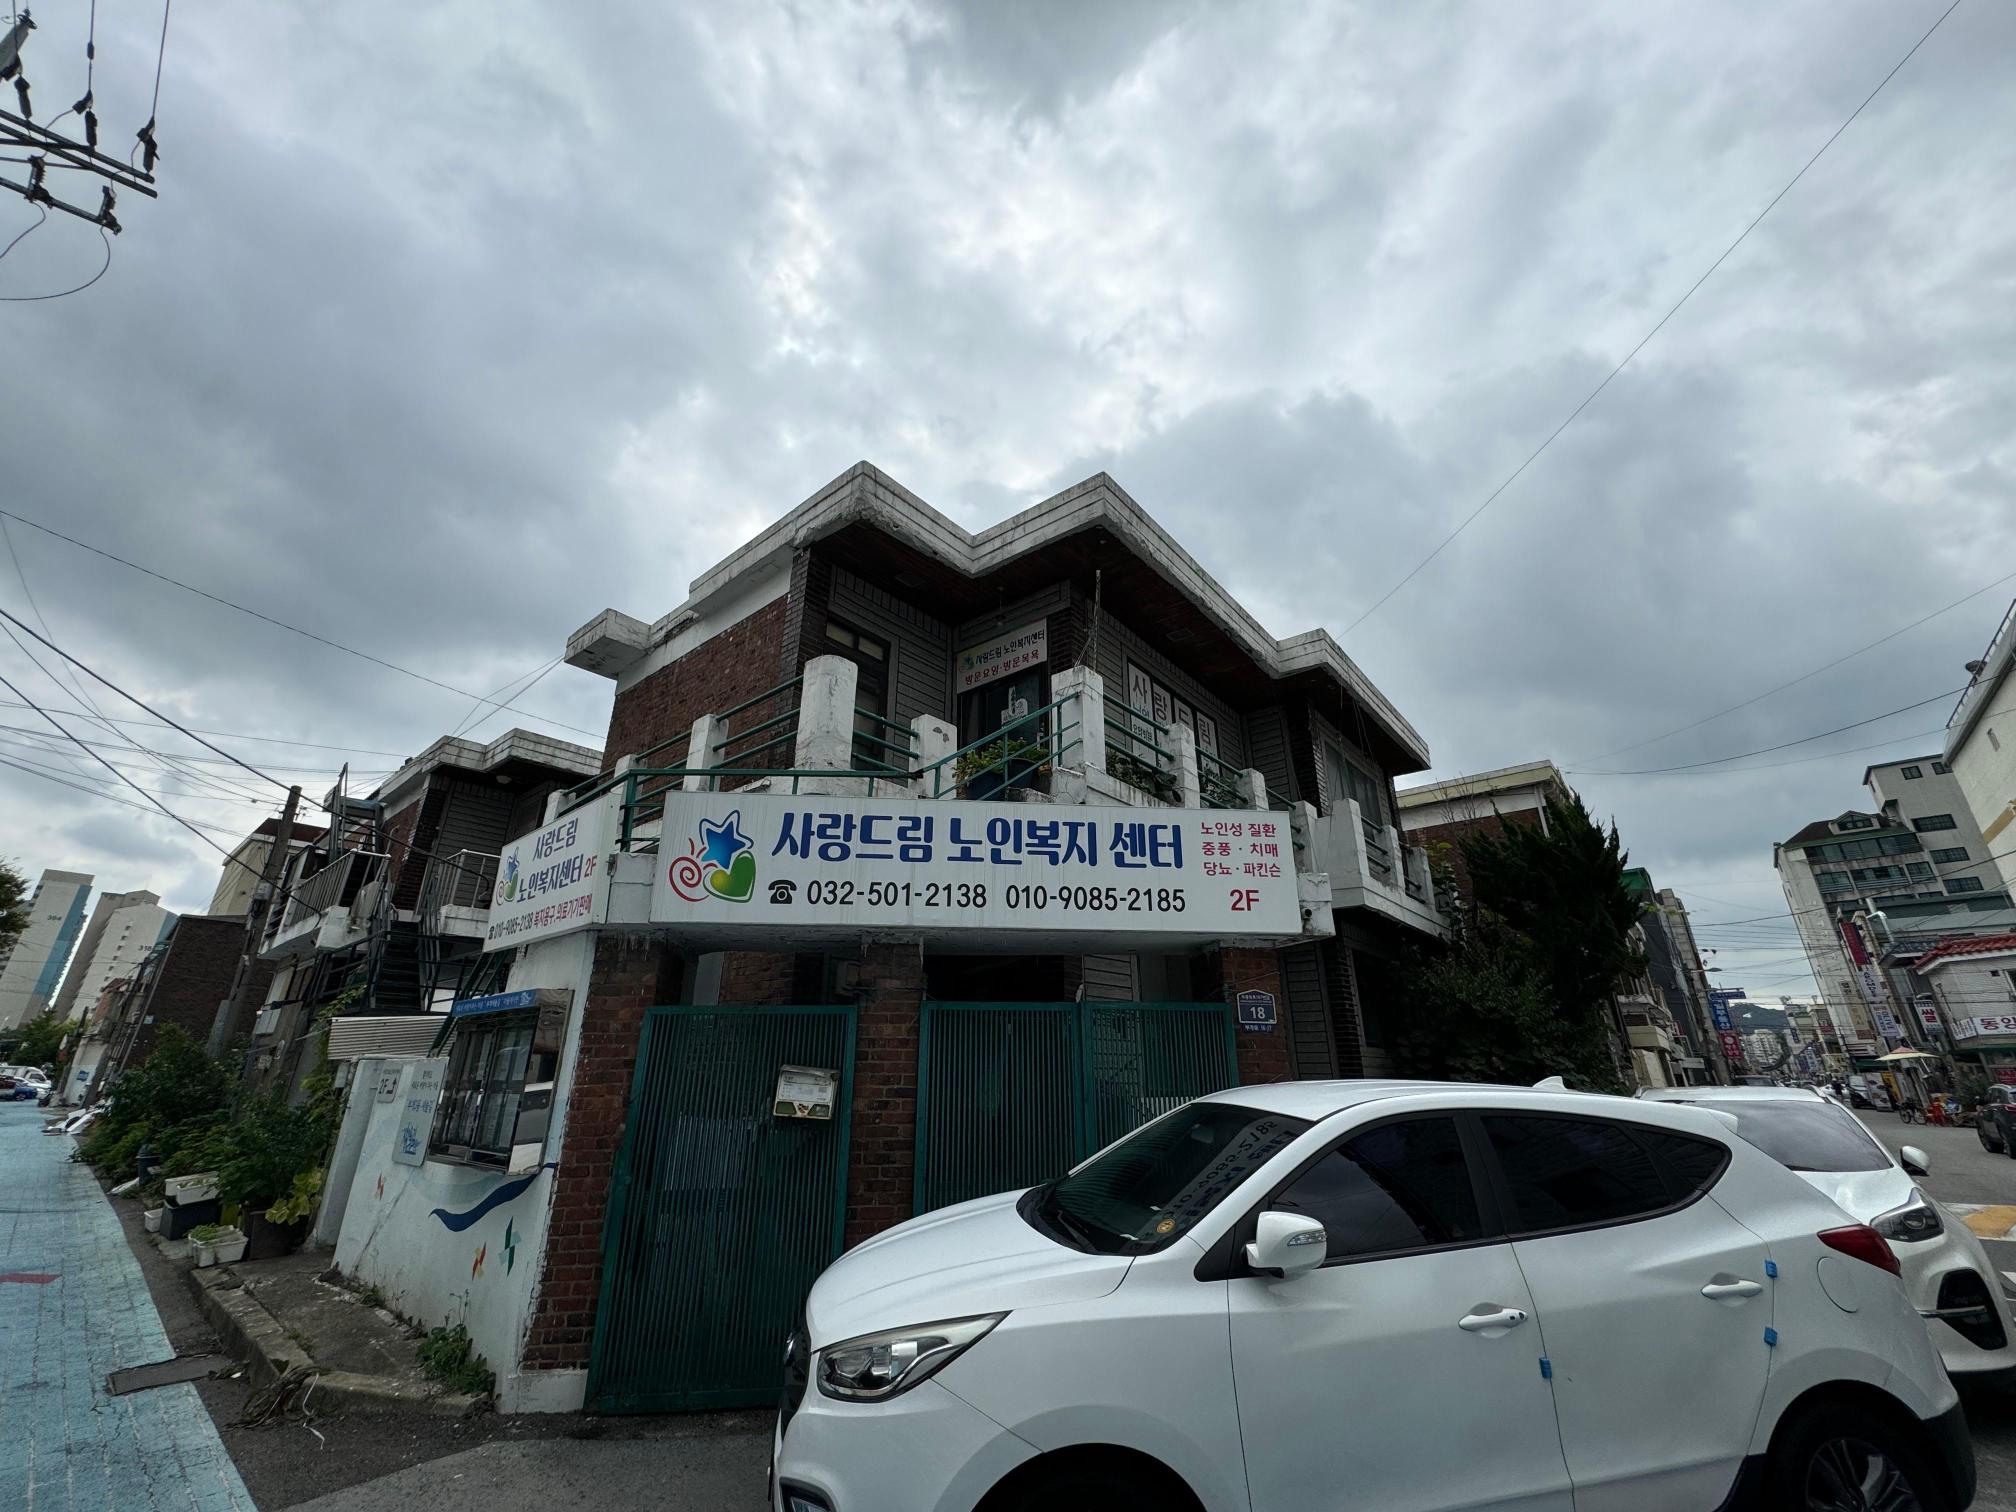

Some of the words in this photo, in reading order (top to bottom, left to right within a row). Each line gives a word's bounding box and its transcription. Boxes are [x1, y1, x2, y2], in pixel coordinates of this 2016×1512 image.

[975, 646, 1002, 665] 사랑드림
[1003, 629, 1045, 655] 노인복지센터
[532, 817, 579, 862] 사랑드림
[771, 812, 934, 863] 사랑드림
[947, 817, 1098, 867] 노인복지
[1109, 822, 1183, 869] 센터
[1201, 822, 1243, 837] 노인성
[1248, 823, 1277, 838] 질환
[1202, 841, 1232, 857] 중풍
[1249, 842, 1279, 858] 치매
[516, 853, 585, 903] 노인복지센터
[584, 855, 597, 877] 2F
[807, 880, 988, 908] 032-501-2138
[1005, 885, 1186, 912] 010-9085-2185
[1229, 889, 1260, 911] 2F
[1249, 1006, 1266, 1019] 18
[1921, 1008, 1938, 1023] 쌀
